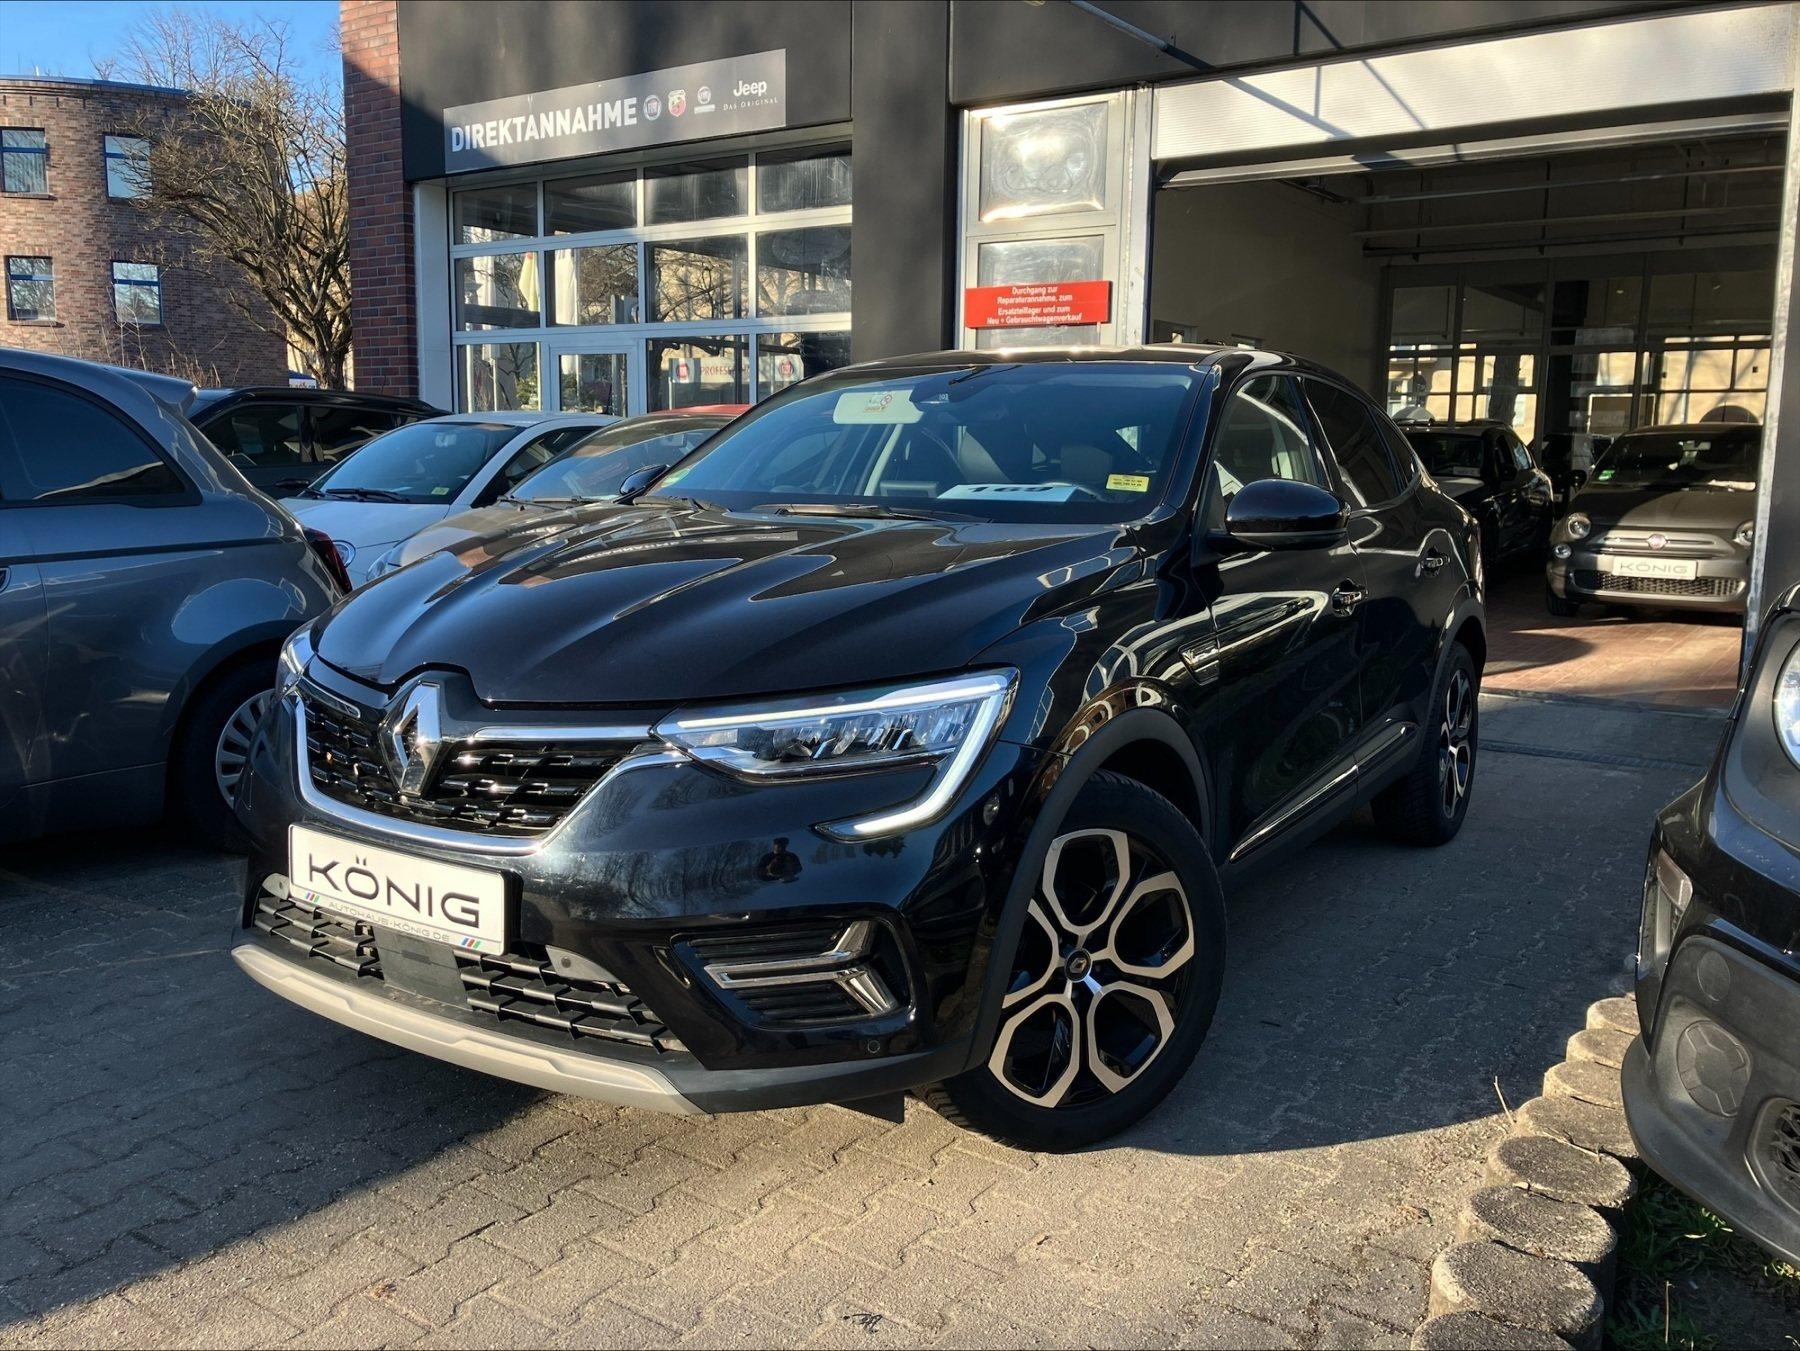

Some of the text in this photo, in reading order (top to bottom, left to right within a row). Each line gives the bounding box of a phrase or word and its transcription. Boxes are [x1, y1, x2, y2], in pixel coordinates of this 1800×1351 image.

[733, 80, 767, 97] Jeep
[451, 97, 638, 152] DIREKTANNAHME
[1012, 287, 1046, 295] Durchgang
[998, 306, 1041, 316] Ersatzteillager
[1042, 305, 1056, 313] und
[987, 317, 999, 325] Neu
[1006, 313, 1082, 324] Gebrauchtwagenverkauf
[1620, 562, 1688, 574] KÖNIG
[308, 853, 480, 928] KÖNIG
